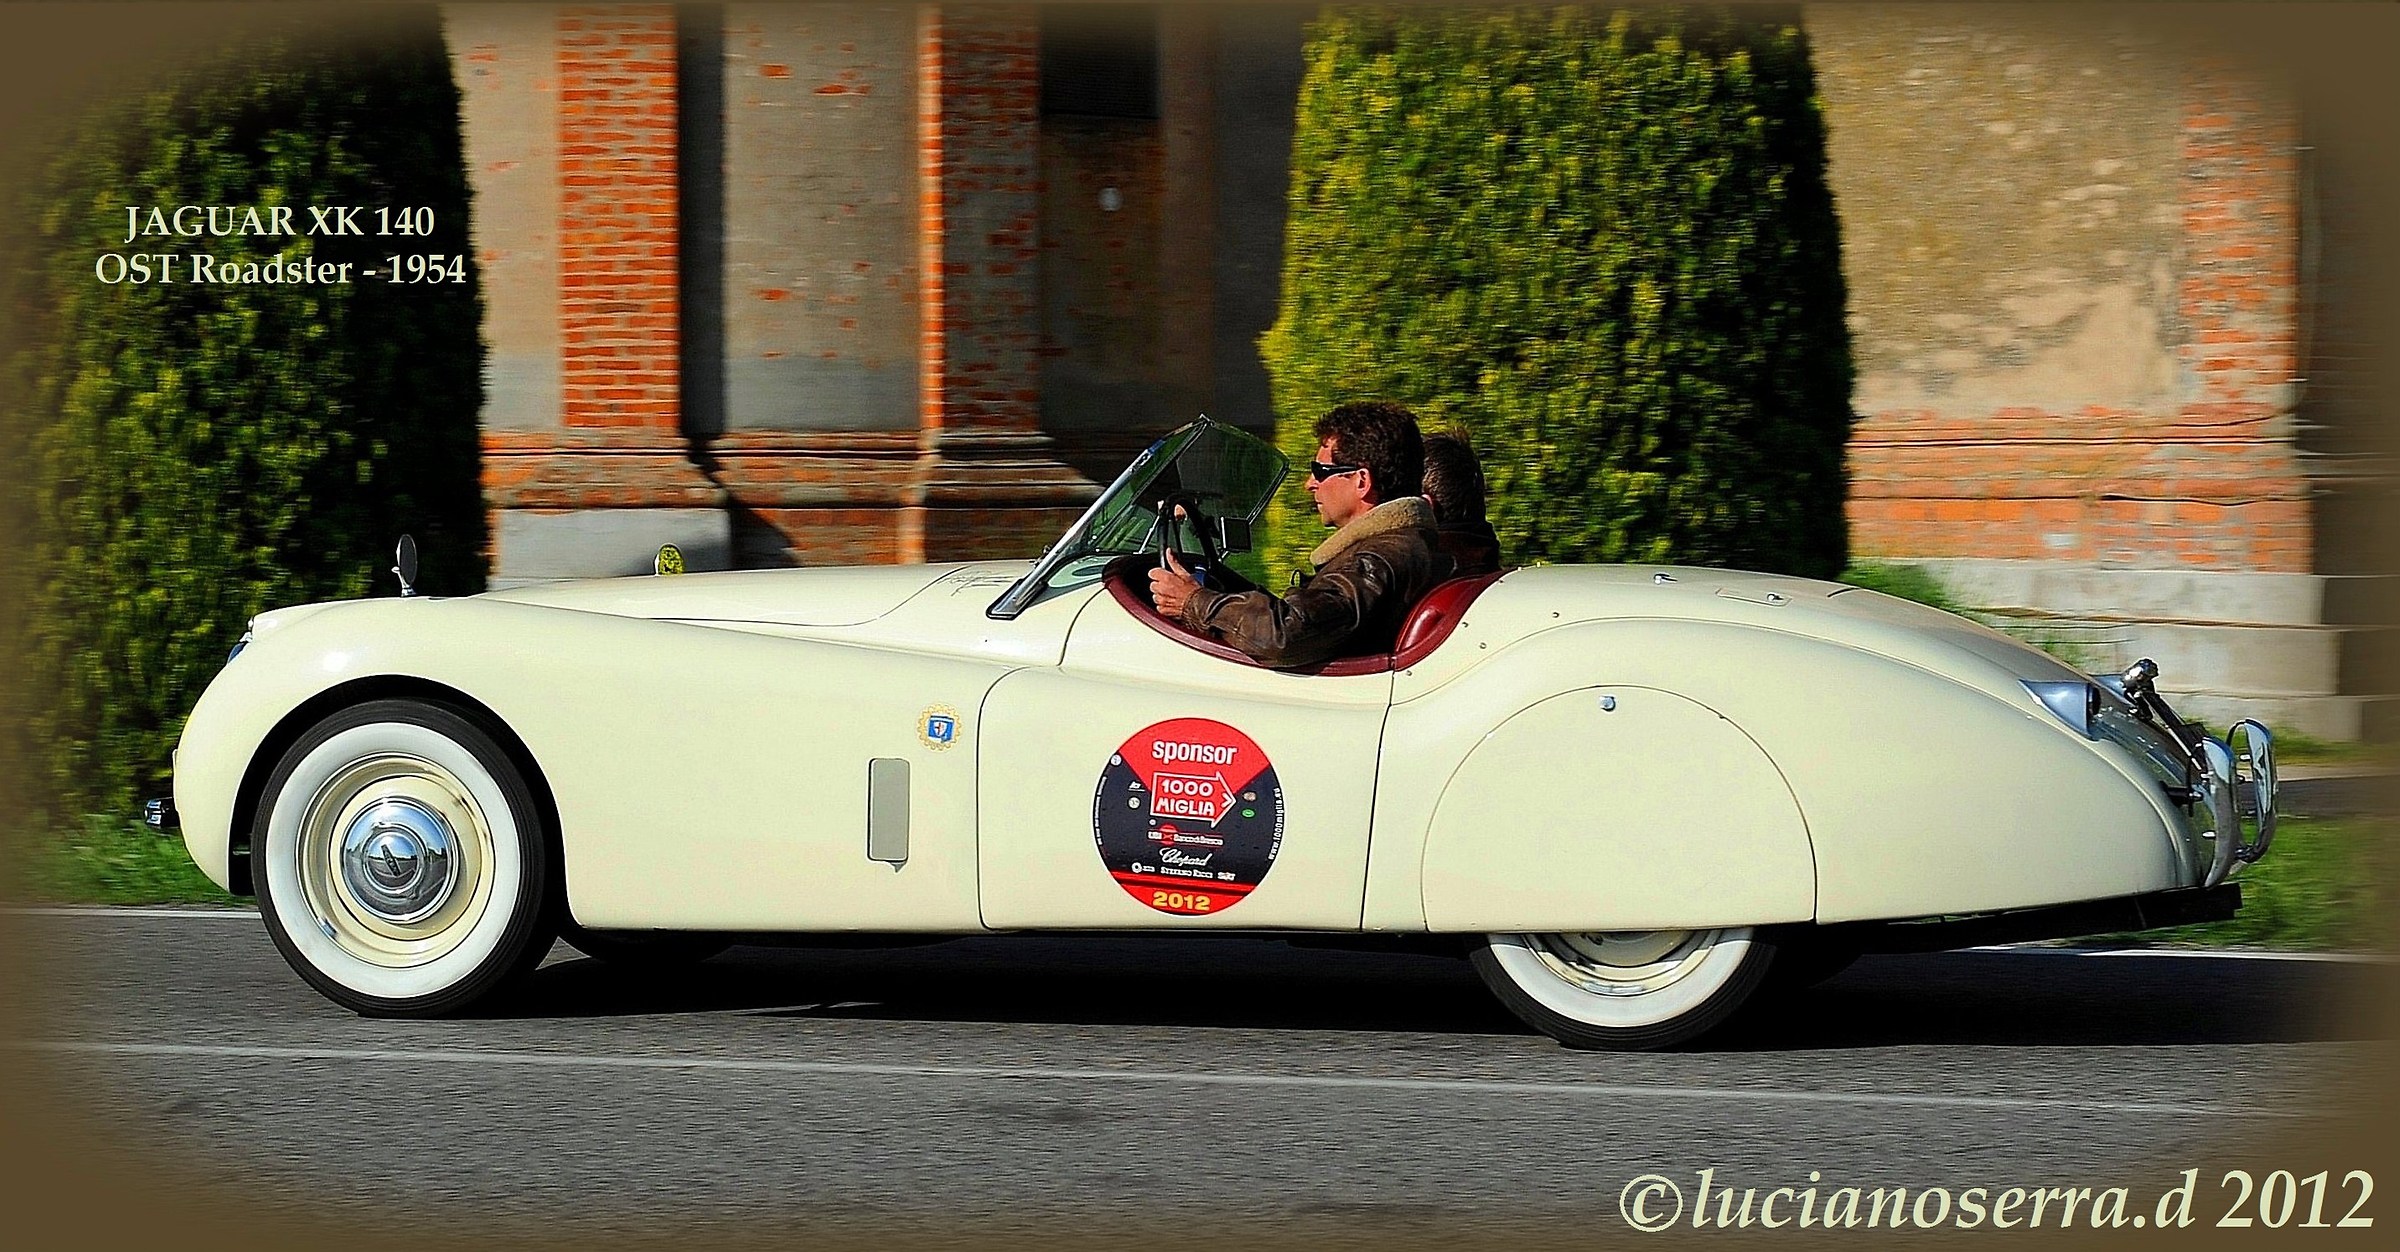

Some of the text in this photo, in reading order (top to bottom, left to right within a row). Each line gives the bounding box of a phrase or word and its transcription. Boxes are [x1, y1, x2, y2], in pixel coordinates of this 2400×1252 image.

[1152, 740, 1237, 765] sponsor
[1162, 779, 1214, 797] 1000
[1155, 797, 1216, 817] MIGLIA
[1152, 891, 1211, 911] 2012
